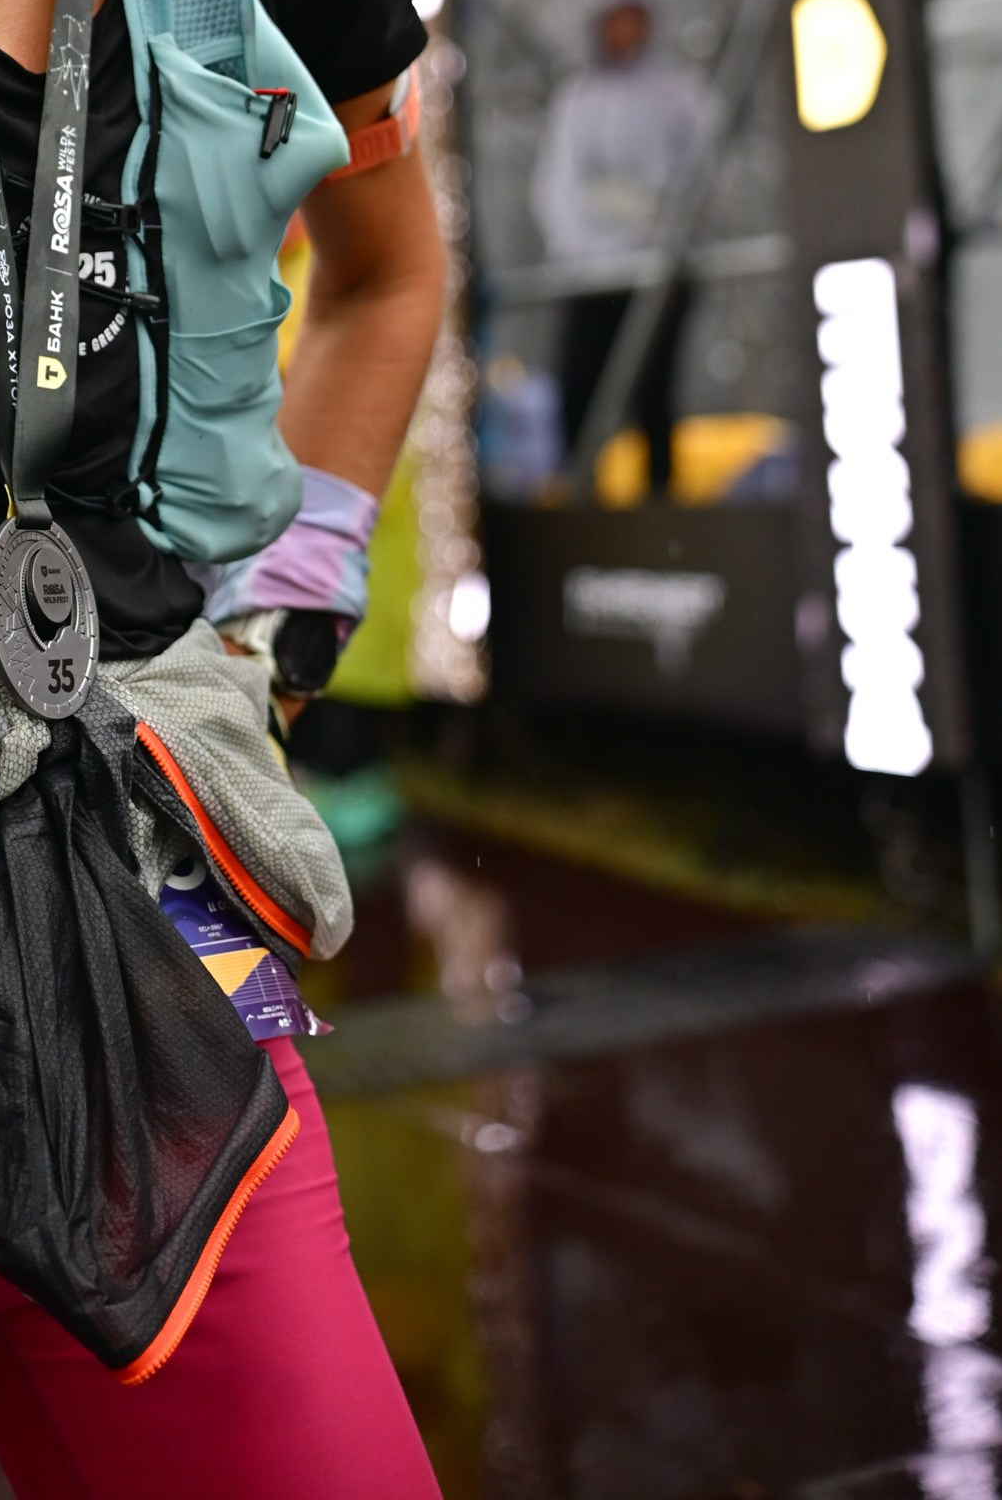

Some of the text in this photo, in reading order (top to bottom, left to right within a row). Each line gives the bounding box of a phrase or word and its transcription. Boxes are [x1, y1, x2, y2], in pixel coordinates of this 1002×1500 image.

[57, 136, 68, 171] WILD
[66, 139, 77, 173] FEST
[3, 293, 15, 343] РОЗА
[47, 290, 65, 353] БАНК
[47, 658, 75, 694] 35
